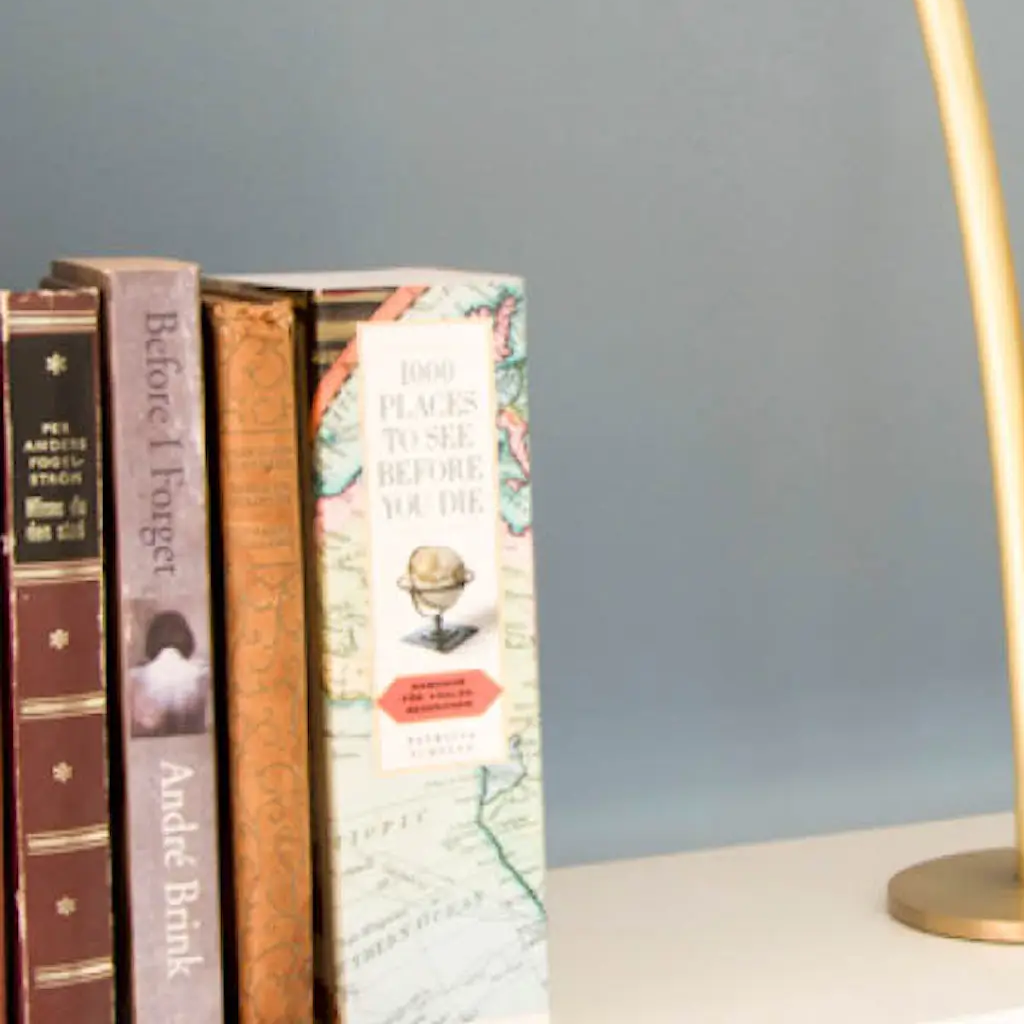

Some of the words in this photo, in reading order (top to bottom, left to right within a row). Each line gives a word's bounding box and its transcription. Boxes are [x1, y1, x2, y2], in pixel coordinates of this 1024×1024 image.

[144, 311, 183, 425] Before
[400, 356, 457, 387] 1000
[379, 390, 478, 421] PLACES
[381, 427, 419, 456] TO
[426, 422, 476, 452] SEE
[377, 454, 484, 487] BEFORE
[382, 493, 425, 520] YOU
[438, 487, 484, 518] DIE
[138, 467, 185, 576] Forget
[159, 760, 199, 870] André
[164, 880, 204, 979] Brink
